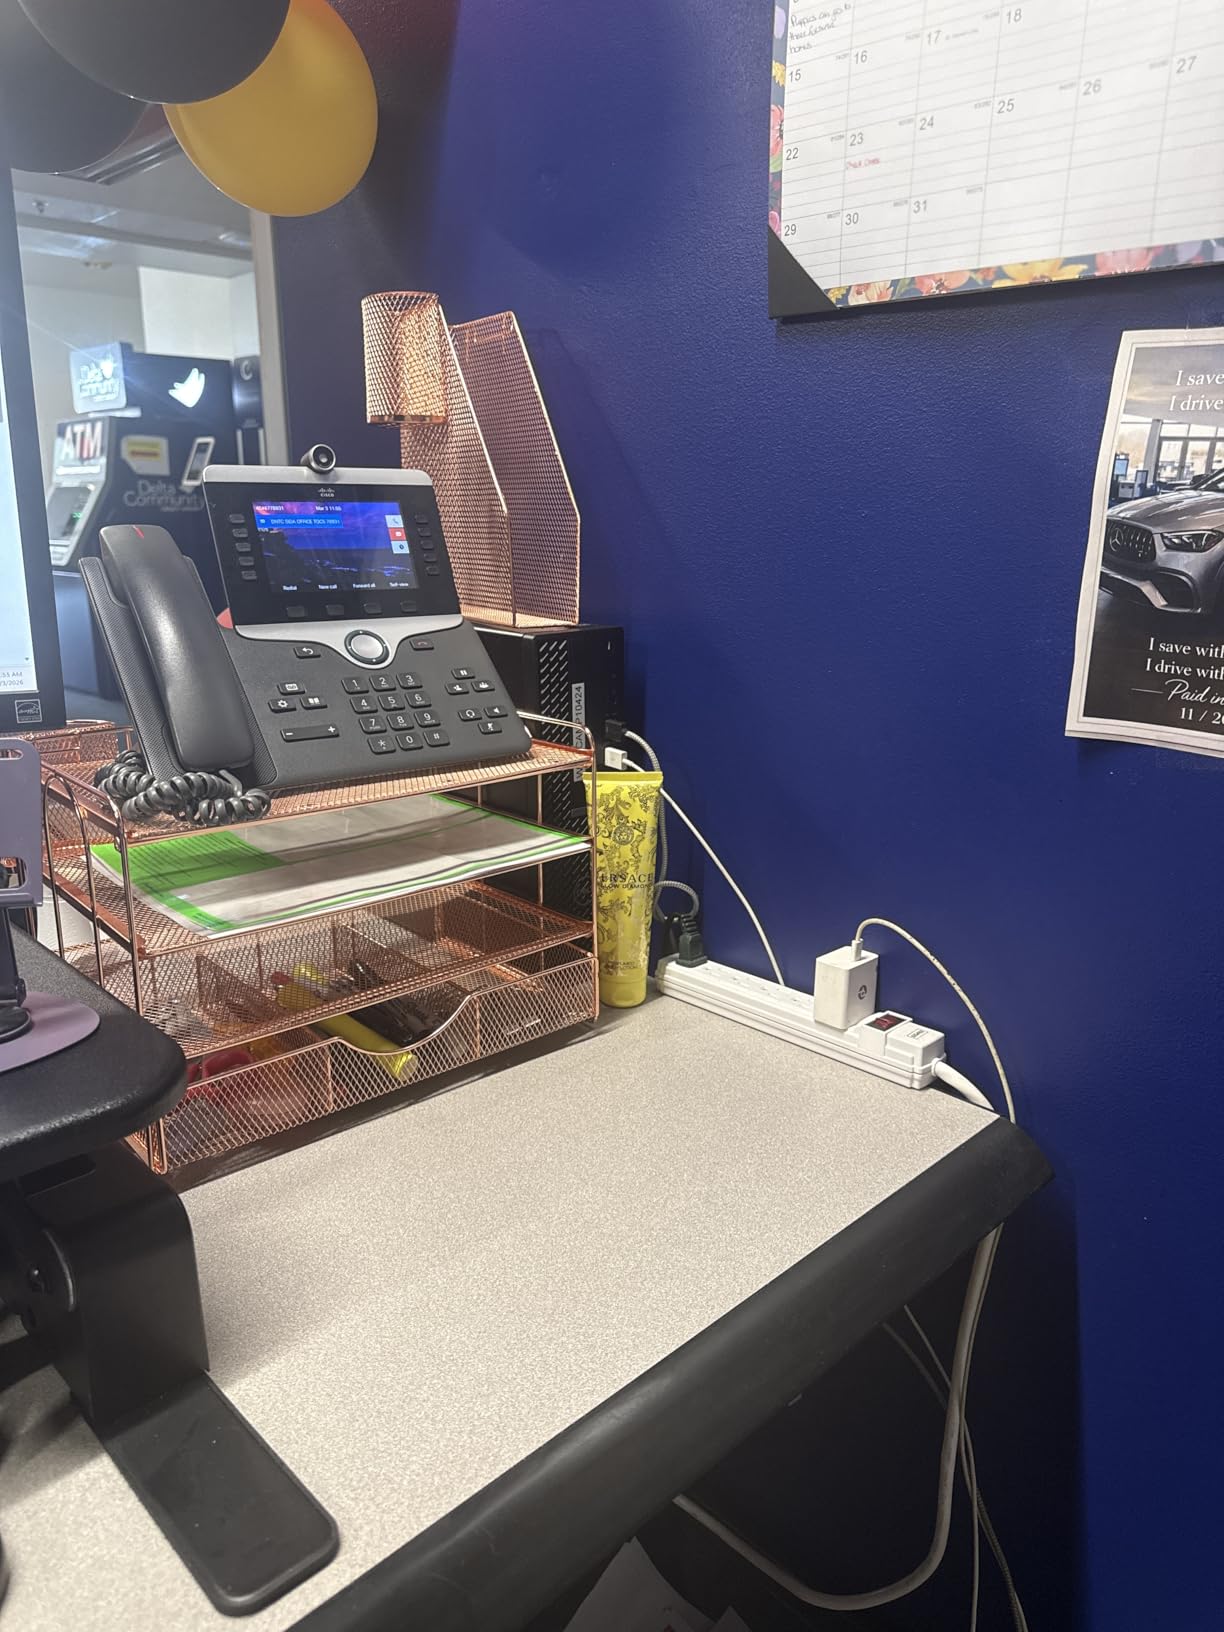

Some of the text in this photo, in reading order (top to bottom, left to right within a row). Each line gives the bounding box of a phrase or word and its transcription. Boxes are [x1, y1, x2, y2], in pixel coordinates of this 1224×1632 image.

[1006, 8, 1022, 23] 18
[928, 30, 941, 45] 17
[854, 50, 868, 64] 16
[1176, 55, 1197, 74] 27
[789, 69, 801, 82] 15
[1083, 78, 1101, 96] 26
[997, 98, 1015, 114] 25
[920, 116, 934, 130] 24
[849, 132, 864, 146] 23
[786, 147, 799, 160] 22
[913, 200, 927, 213] 31
[845, 212, 859, 225] 30
[784, 223, 797, 237] 29
[1176, 370, 1224, 386] I save
[1170, 394, 1223, 411] I drive
[60, 421, 102, 461] ATM
[138, 479, 176, 496] Delta
[123, 491, 205, 509] Community
[1149, 637, 1155, 651] I
[1159, 642, 1191, 655] save
[1146, 658, 1152, 671] I
[1155, 659, 1192, 676] drive
[1165, 679, 1211, 703] Paid
[1180, 707, 1194, 720] 11
[1199, 710, 1208, 722] /
